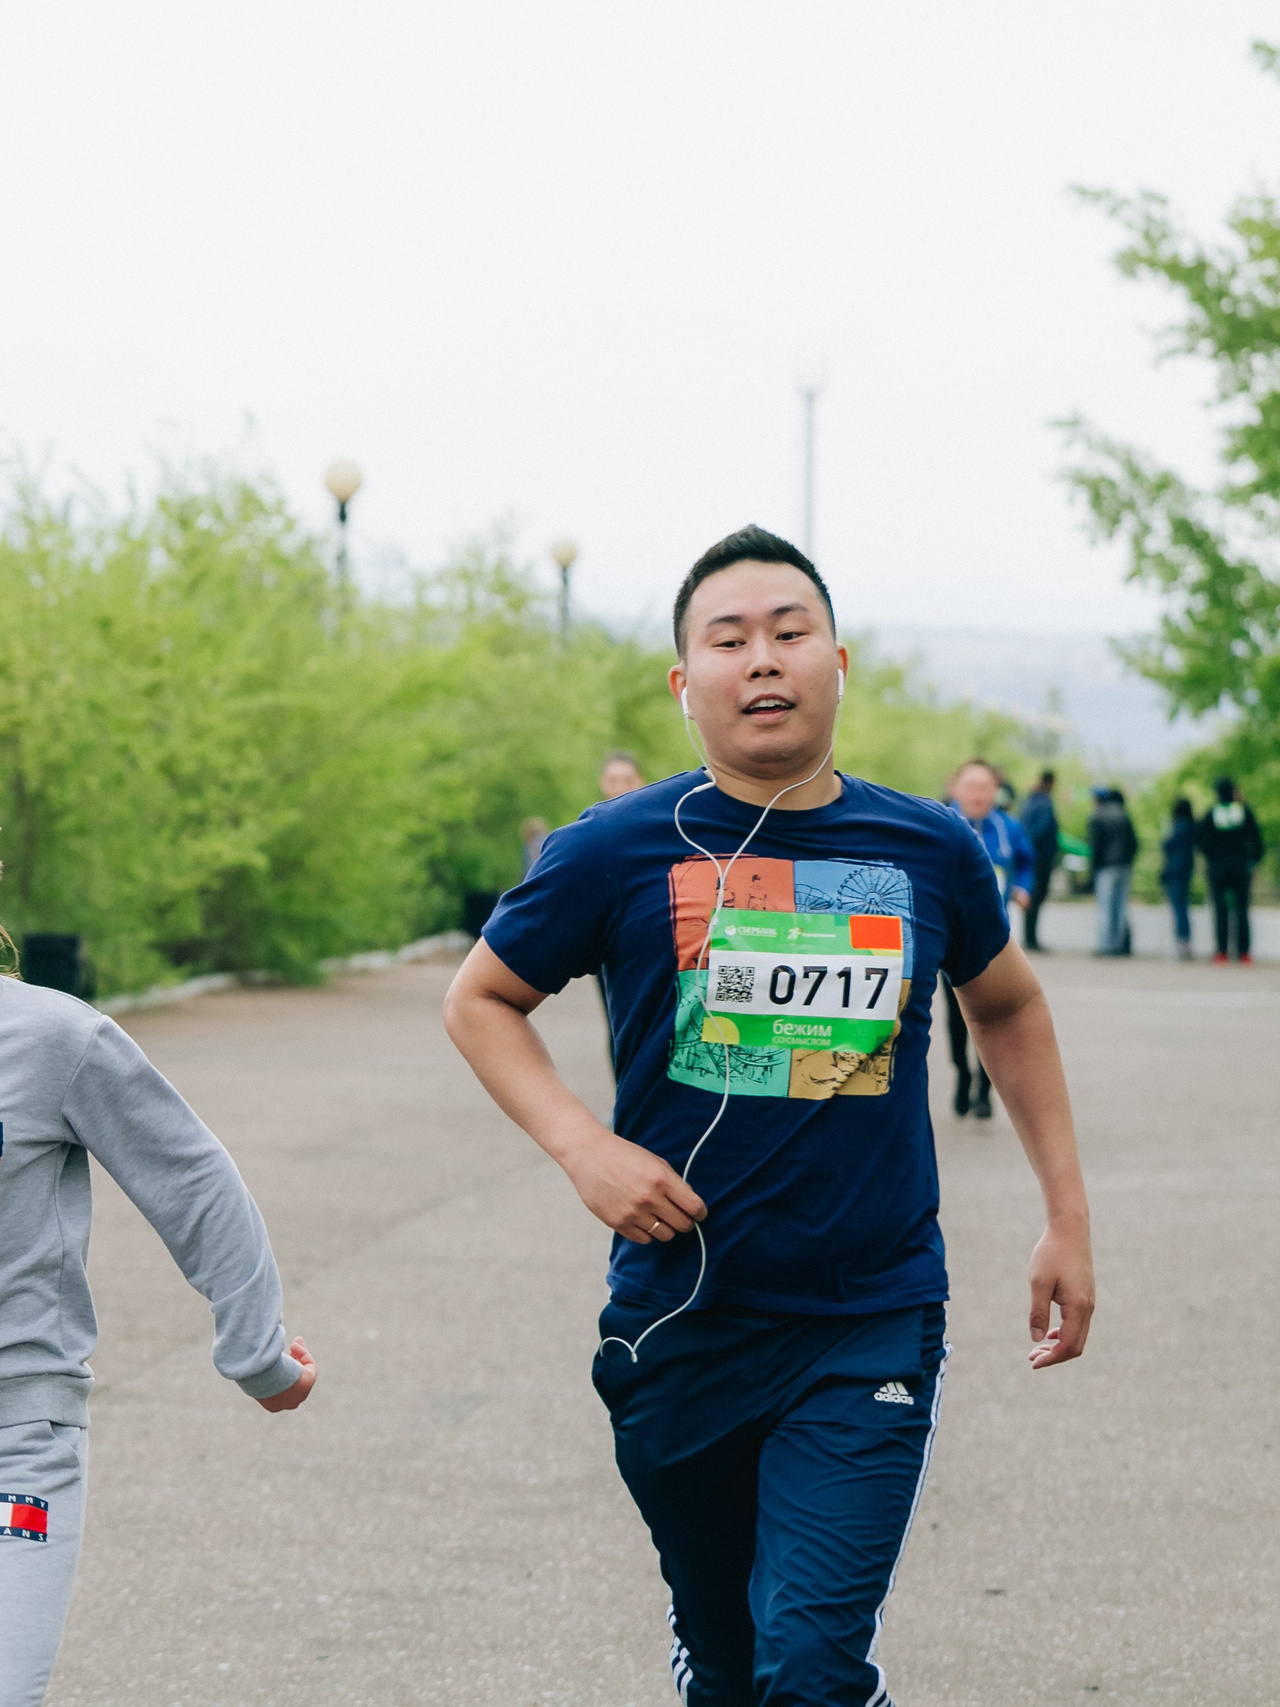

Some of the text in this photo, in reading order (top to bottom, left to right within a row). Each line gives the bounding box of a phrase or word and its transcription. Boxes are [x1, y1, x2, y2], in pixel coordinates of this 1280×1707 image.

[769, 964, 889, 1010] 0717
[773, 1019, 832, 1037] бежим
[874, 1391, 914, 1405] adidas
